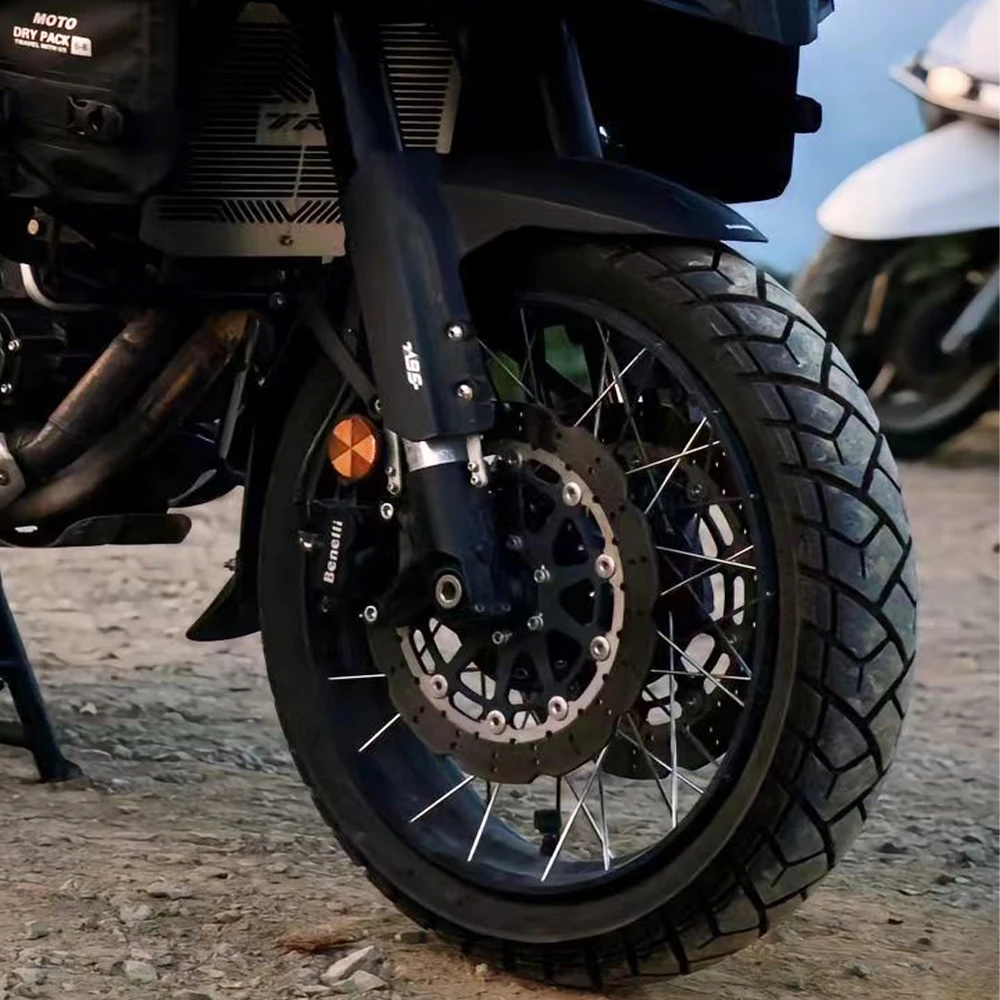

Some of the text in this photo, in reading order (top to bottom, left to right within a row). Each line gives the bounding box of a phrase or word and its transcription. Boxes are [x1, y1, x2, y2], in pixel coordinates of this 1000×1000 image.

[32, 12, 78, 30] MOTO
[13, 26, 38, 40] DRY
[40, 30, 71, 46] PACK
[324, 520, 344, 584] Benelli
